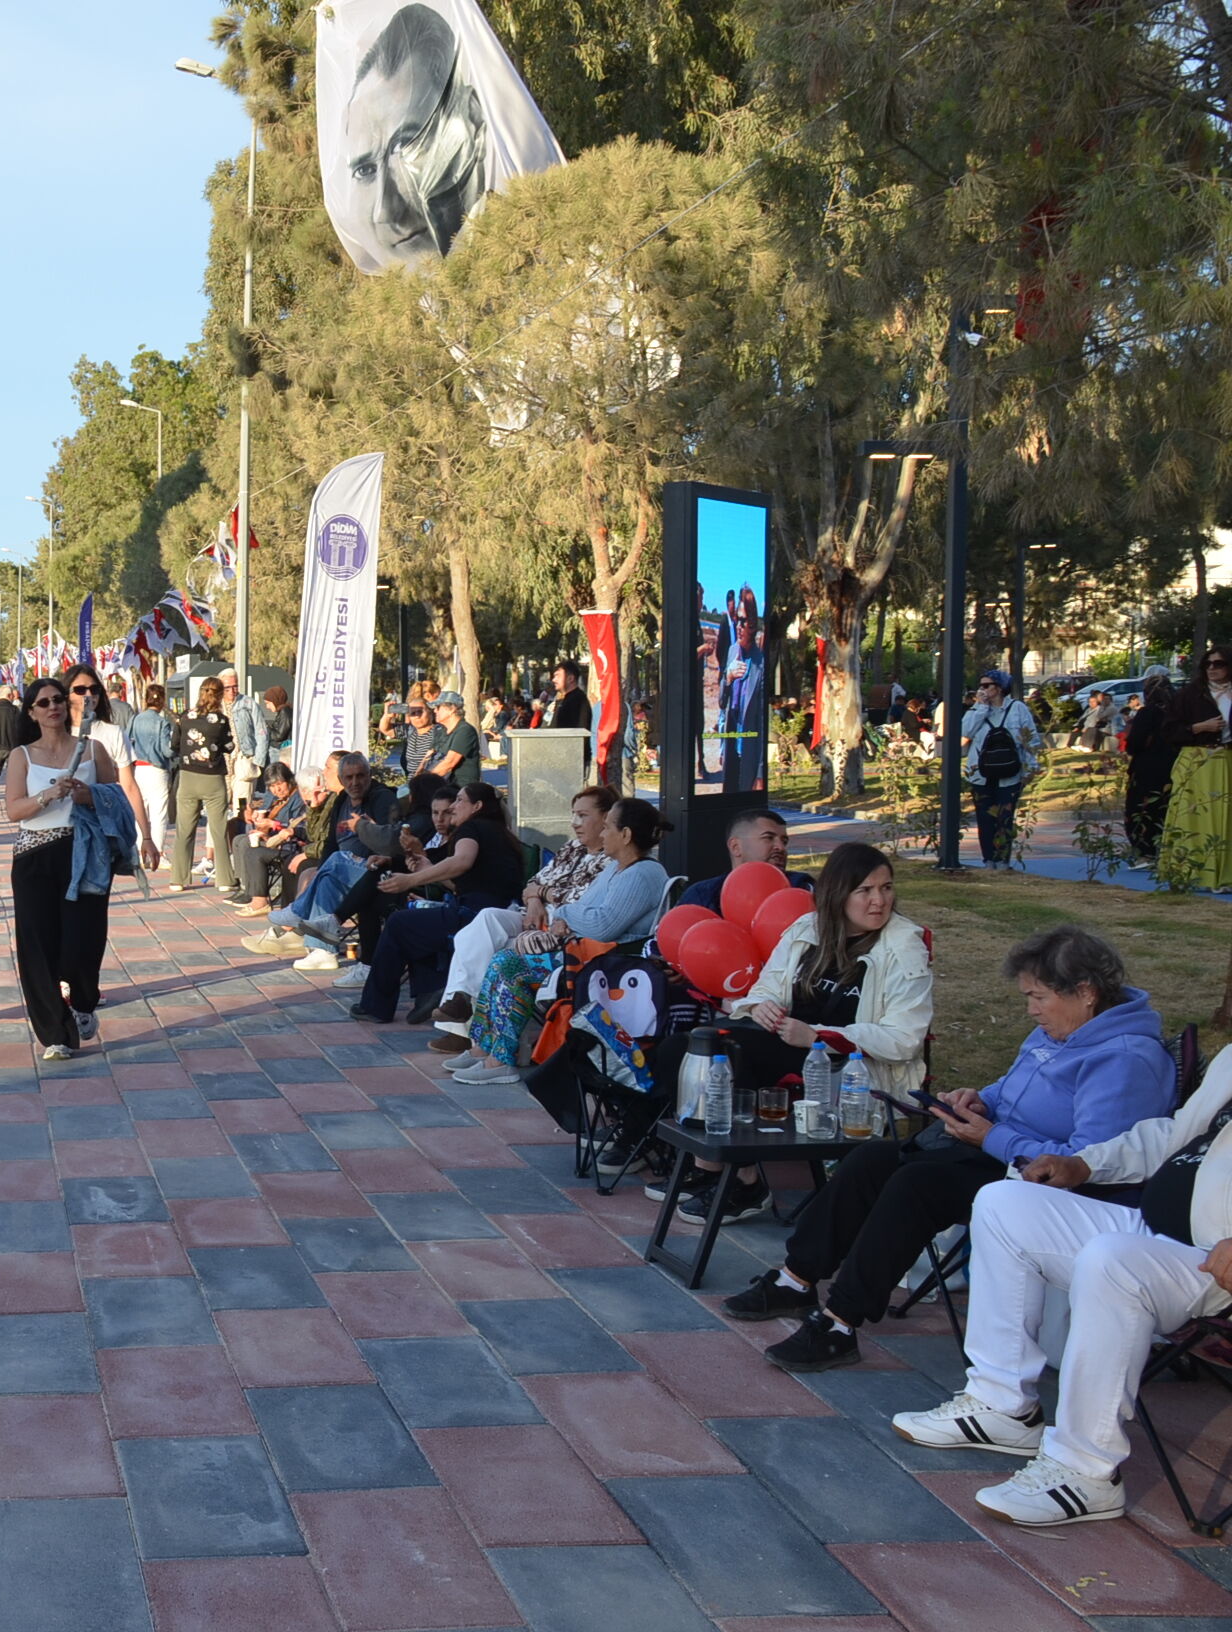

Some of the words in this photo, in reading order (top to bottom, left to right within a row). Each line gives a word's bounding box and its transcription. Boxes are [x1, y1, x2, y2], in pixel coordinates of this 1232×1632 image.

[332, 597, 349, 708] BELEDİYESİ
[313, 666, 327, 698] T.C.
[329, 714, 344, 749] DİM
